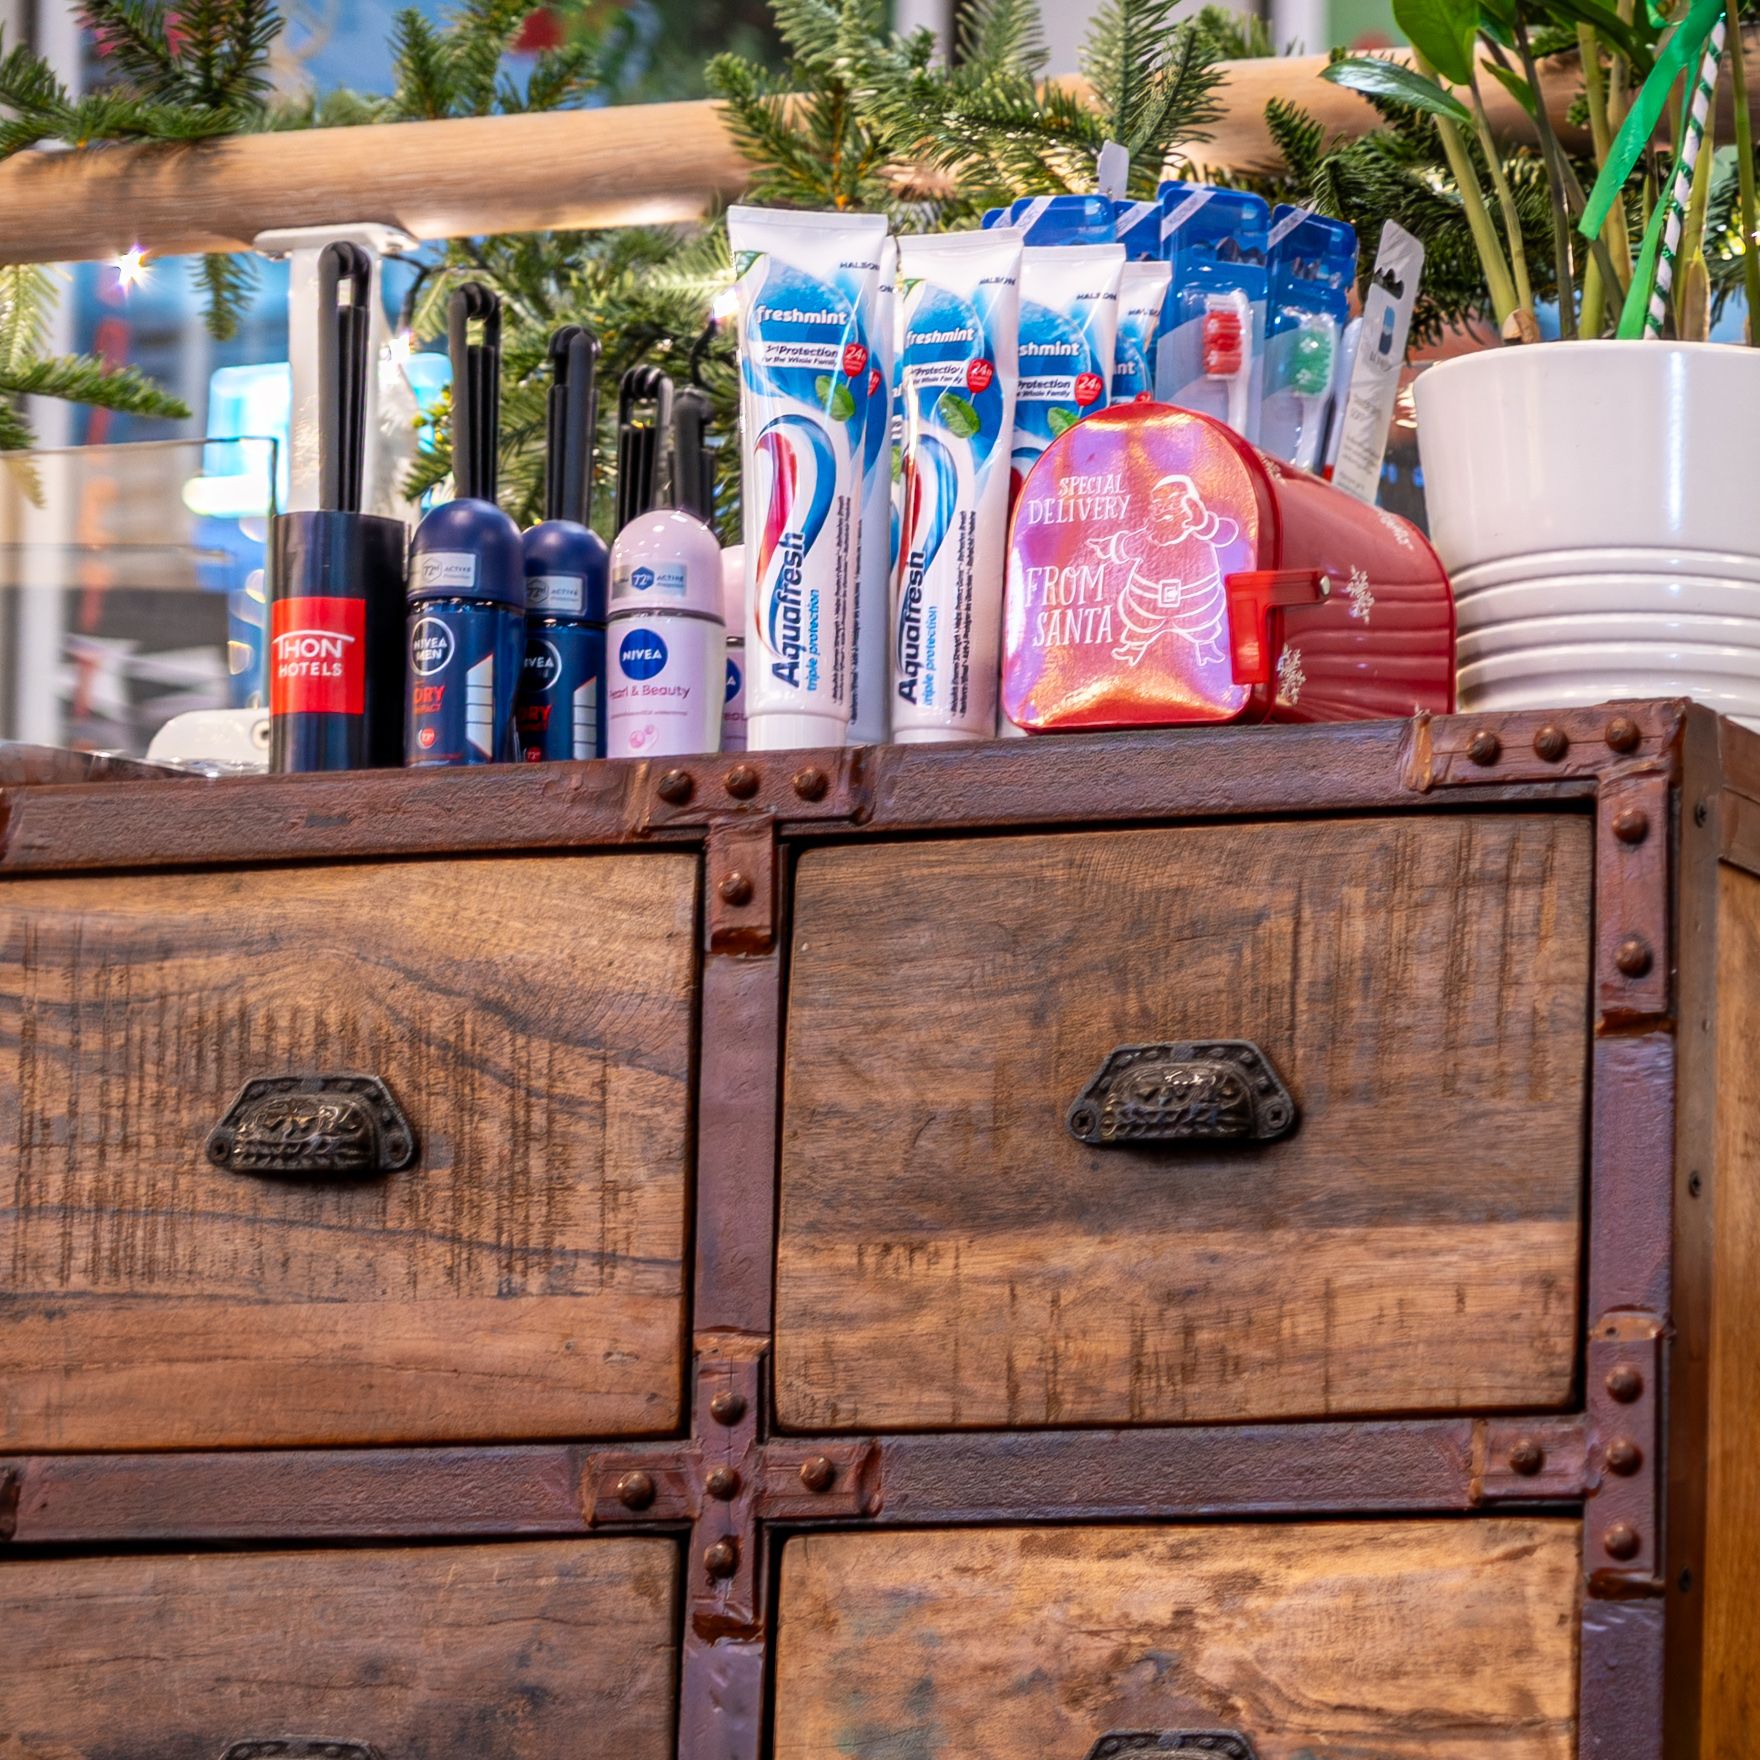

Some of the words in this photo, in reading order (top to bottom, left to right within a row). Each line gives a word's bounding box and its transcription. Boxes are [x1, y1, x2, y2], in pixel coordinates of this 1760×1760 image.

[756, 305, 848, 325] freshmint
[906, 328, 975, 346] freshmint
[1019, 341, 1080, 357] shmint
[1057, 474, 1127, 497] SPECIAL
[1028, 493, 1132, 525] DELIVERY
[1024, 564, 1105, 609] FROM
[772, 532, 807, 689] Aquafresh
[807, 589, 820, 657] protection
[898, 551, 926, 705] Aquafresh
[1032, 605, 1115, 648] SANTA
[272, 630, 356, 661] THON
[413, 637, 448, 651] NIVEA
[924, 606, 938, 671] protection
[415, 649, 443, 661] MEN
[524, 655, 555, 669] IVEA
[622, 648, 663, 662] NIVEA
[278, 661, 343, 678] HOTELS
[806, 658, 820, 692] triple
[413, 684, 446, 704] DRY
[630, 684, 639, 697] &
[641, 684, 691, 700] Beauty
